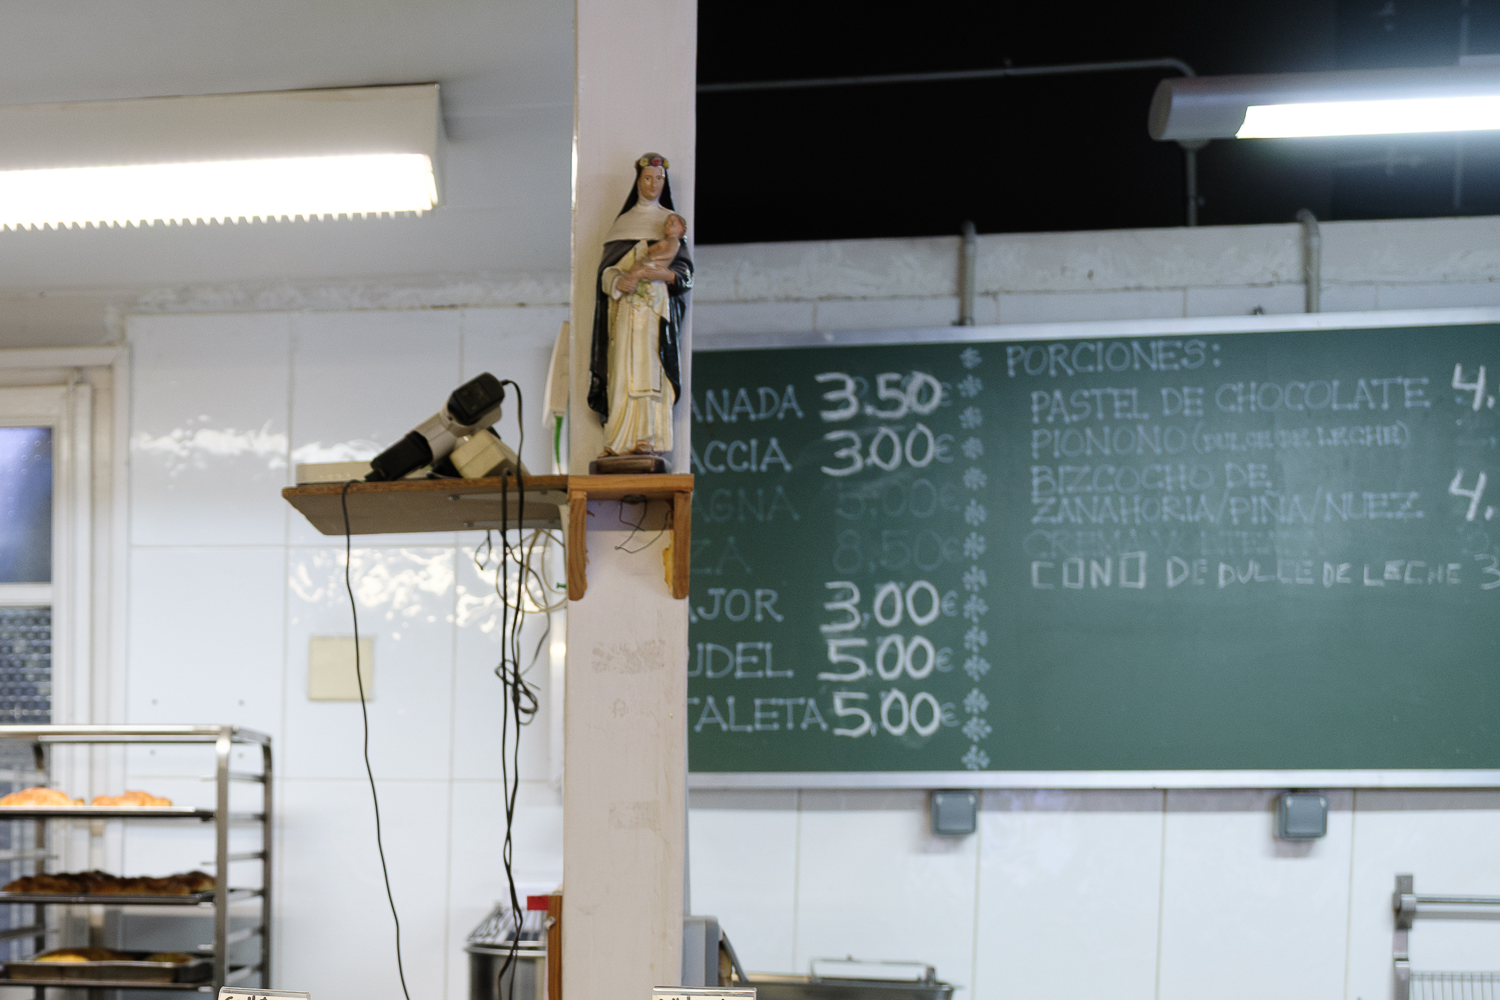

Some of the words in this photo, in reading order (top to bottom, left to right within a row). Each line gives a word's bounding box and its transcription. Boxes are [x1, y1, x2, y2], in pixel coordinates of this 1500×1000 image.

[1005, 340, 1222, 377] PORCIONES:
[1030, 387, 1150, 425] PASTEL
[1160, 386, 1205, 418] DE
[1215, 377, 1432, 414] CHOCOLATE
[1030, 463, 1215, 502] BIZCOCHO
[1224, 462, 1273, 490] DE
[1030, 550, 1148, 591] CONO
[1165, 555, 1208, 590] DE
[1322, 561, 1353, 589] DE
[688, 588, 784, 623] JOR
[687, 695, 828, 733] ALETA
